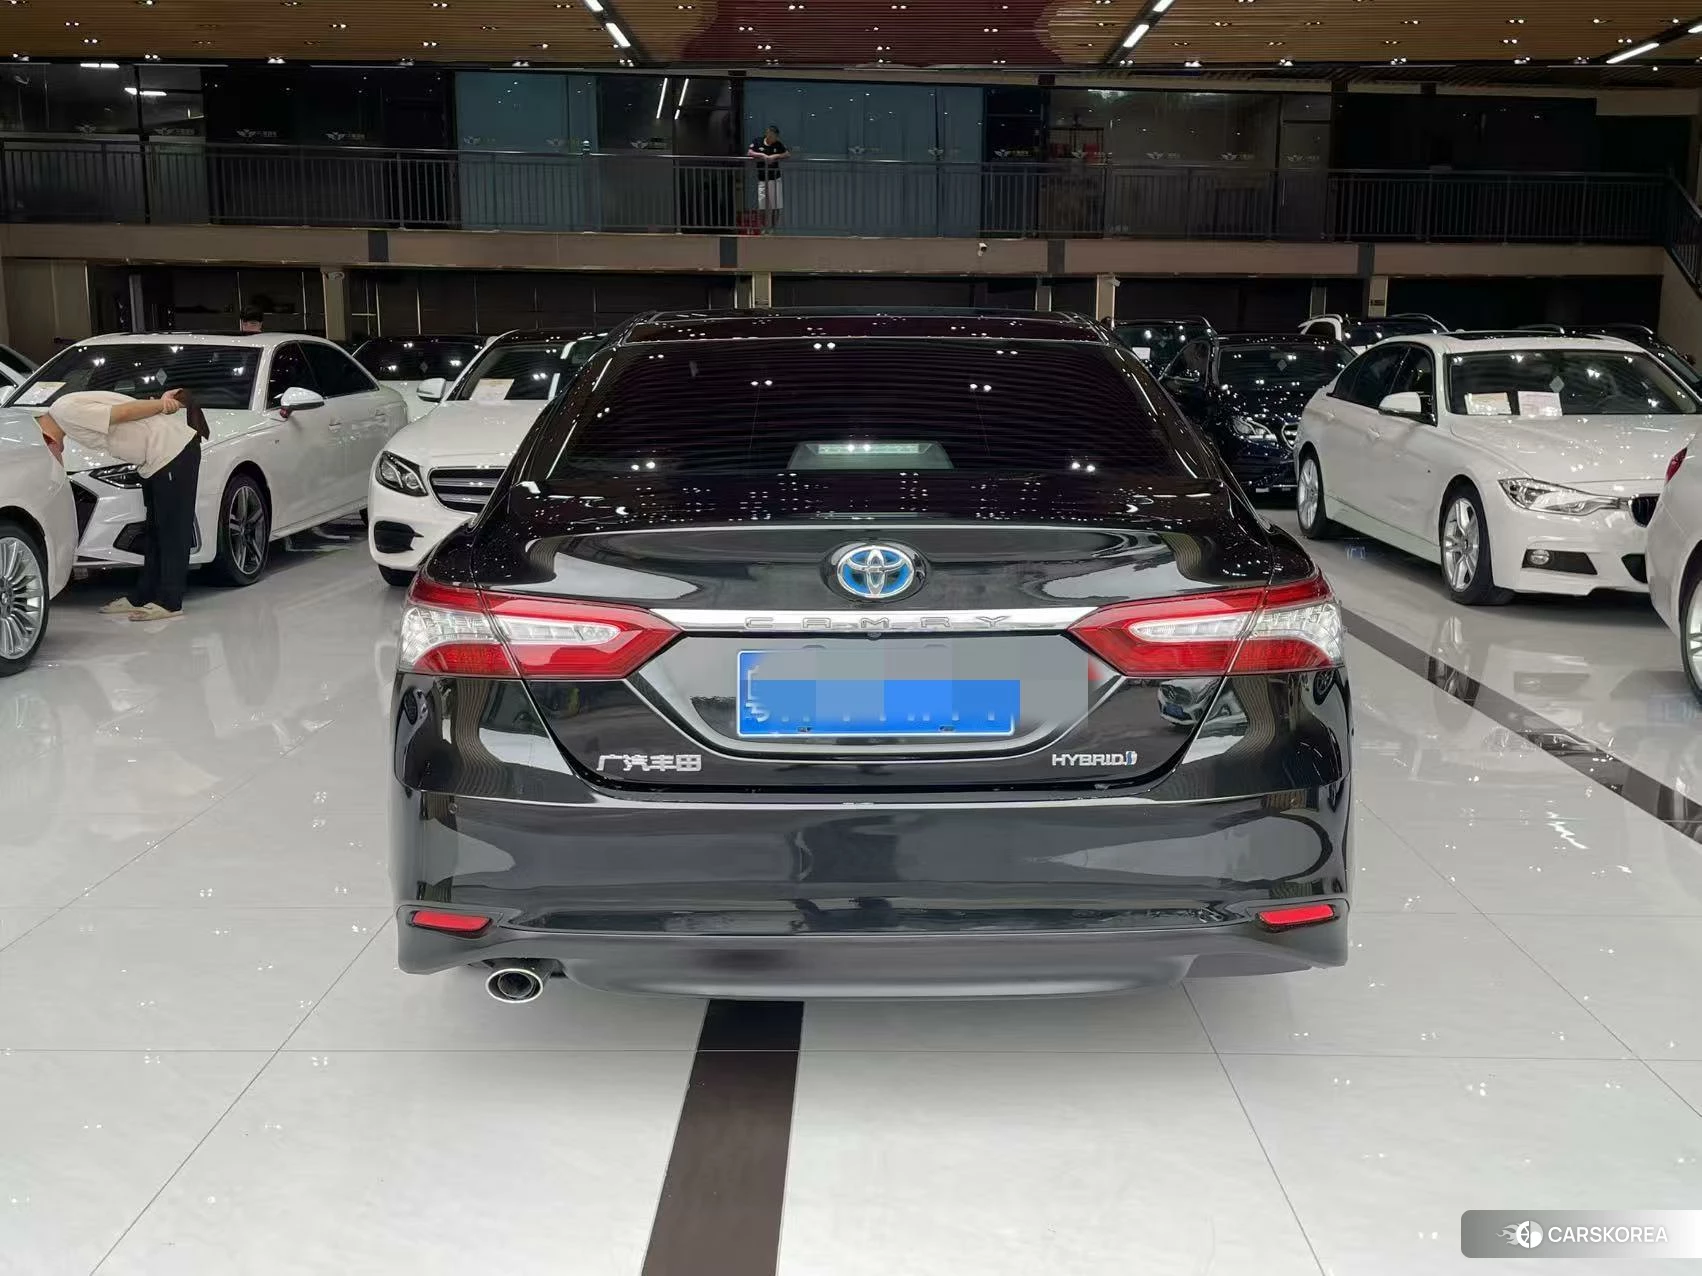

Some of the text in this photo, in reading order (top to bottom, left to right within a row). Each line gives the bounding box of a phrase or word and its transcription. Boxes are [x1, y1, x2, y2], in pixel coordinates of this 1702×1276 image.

[744, 615, 1010, 629] CAMRY
[596, 753, 702, 772] 广汽丰田
[1051, 753, 1125, 766] HYBRID
